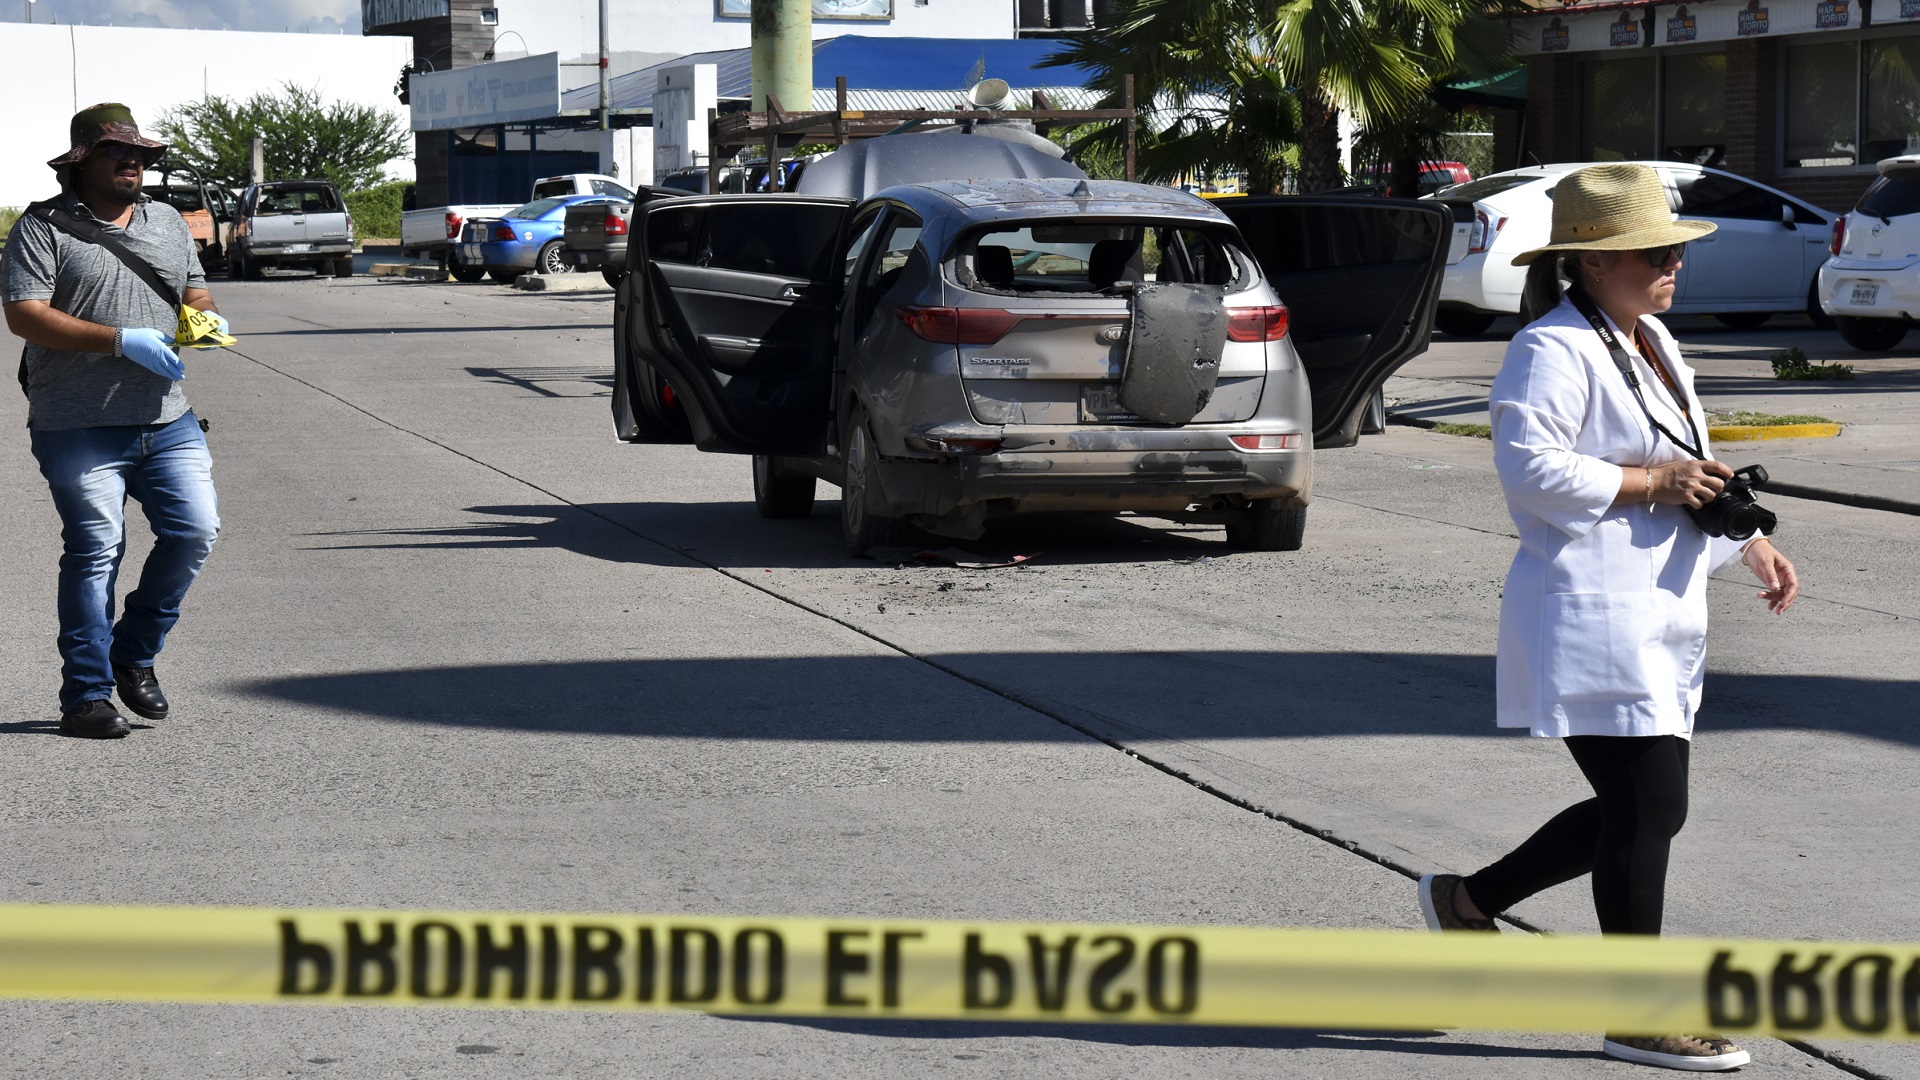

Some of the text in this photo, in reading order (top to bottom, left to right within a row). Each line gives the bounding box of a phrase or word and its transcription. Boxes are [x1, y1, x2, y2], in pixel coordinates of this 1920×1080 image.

[1740, 12, 1755, 22] MAR
[1821, 12, 1847, 23] TORITO
[1668, 20, 1683, 30] MAR
[1743, 20, 1768, 31] TORITO
[1615, 32, 1638, 42] TORITO
[1671, 28, 1695, 37] TORITO
[189, 311, 208, 326] 03
[178, 319, 189, 334] 03
[1590, 315, 1613, 343] Canon
